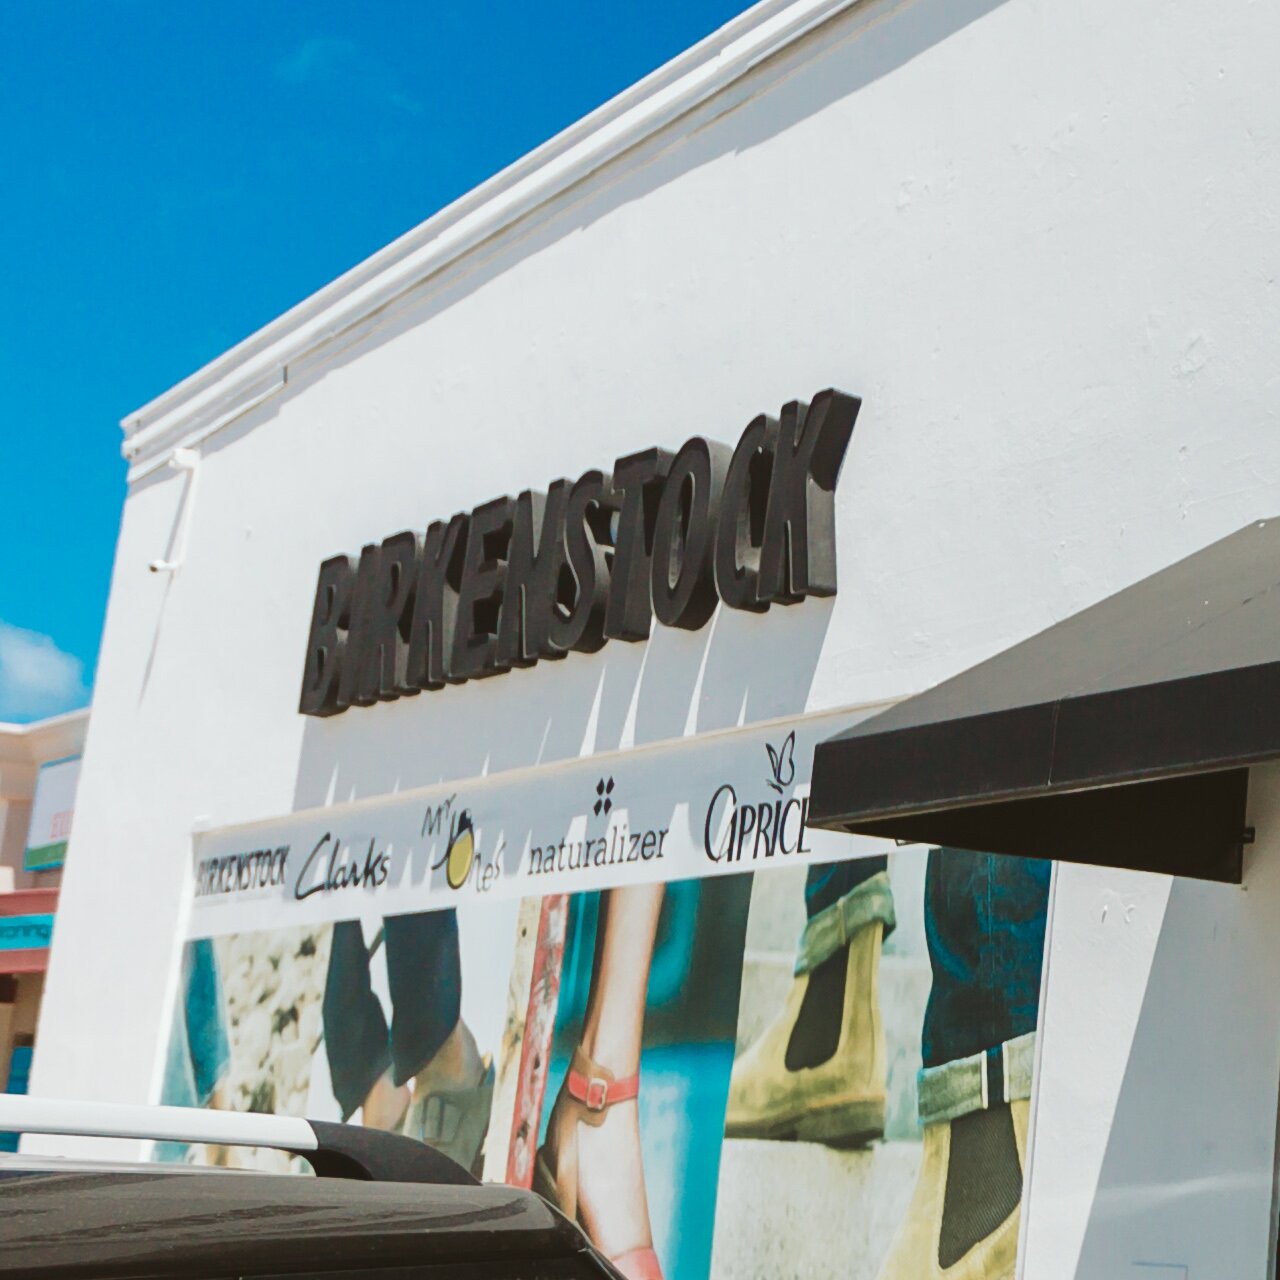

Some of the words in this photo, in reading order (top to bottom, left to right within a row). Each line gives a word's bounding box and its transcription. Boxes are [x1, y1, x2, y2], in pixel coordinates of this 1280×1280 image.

[298, 387, 862, 717] BIRKENSTOCK
[294, 831, 392, 901] Clarks
[527, 826, 670, 876] naturalizer
